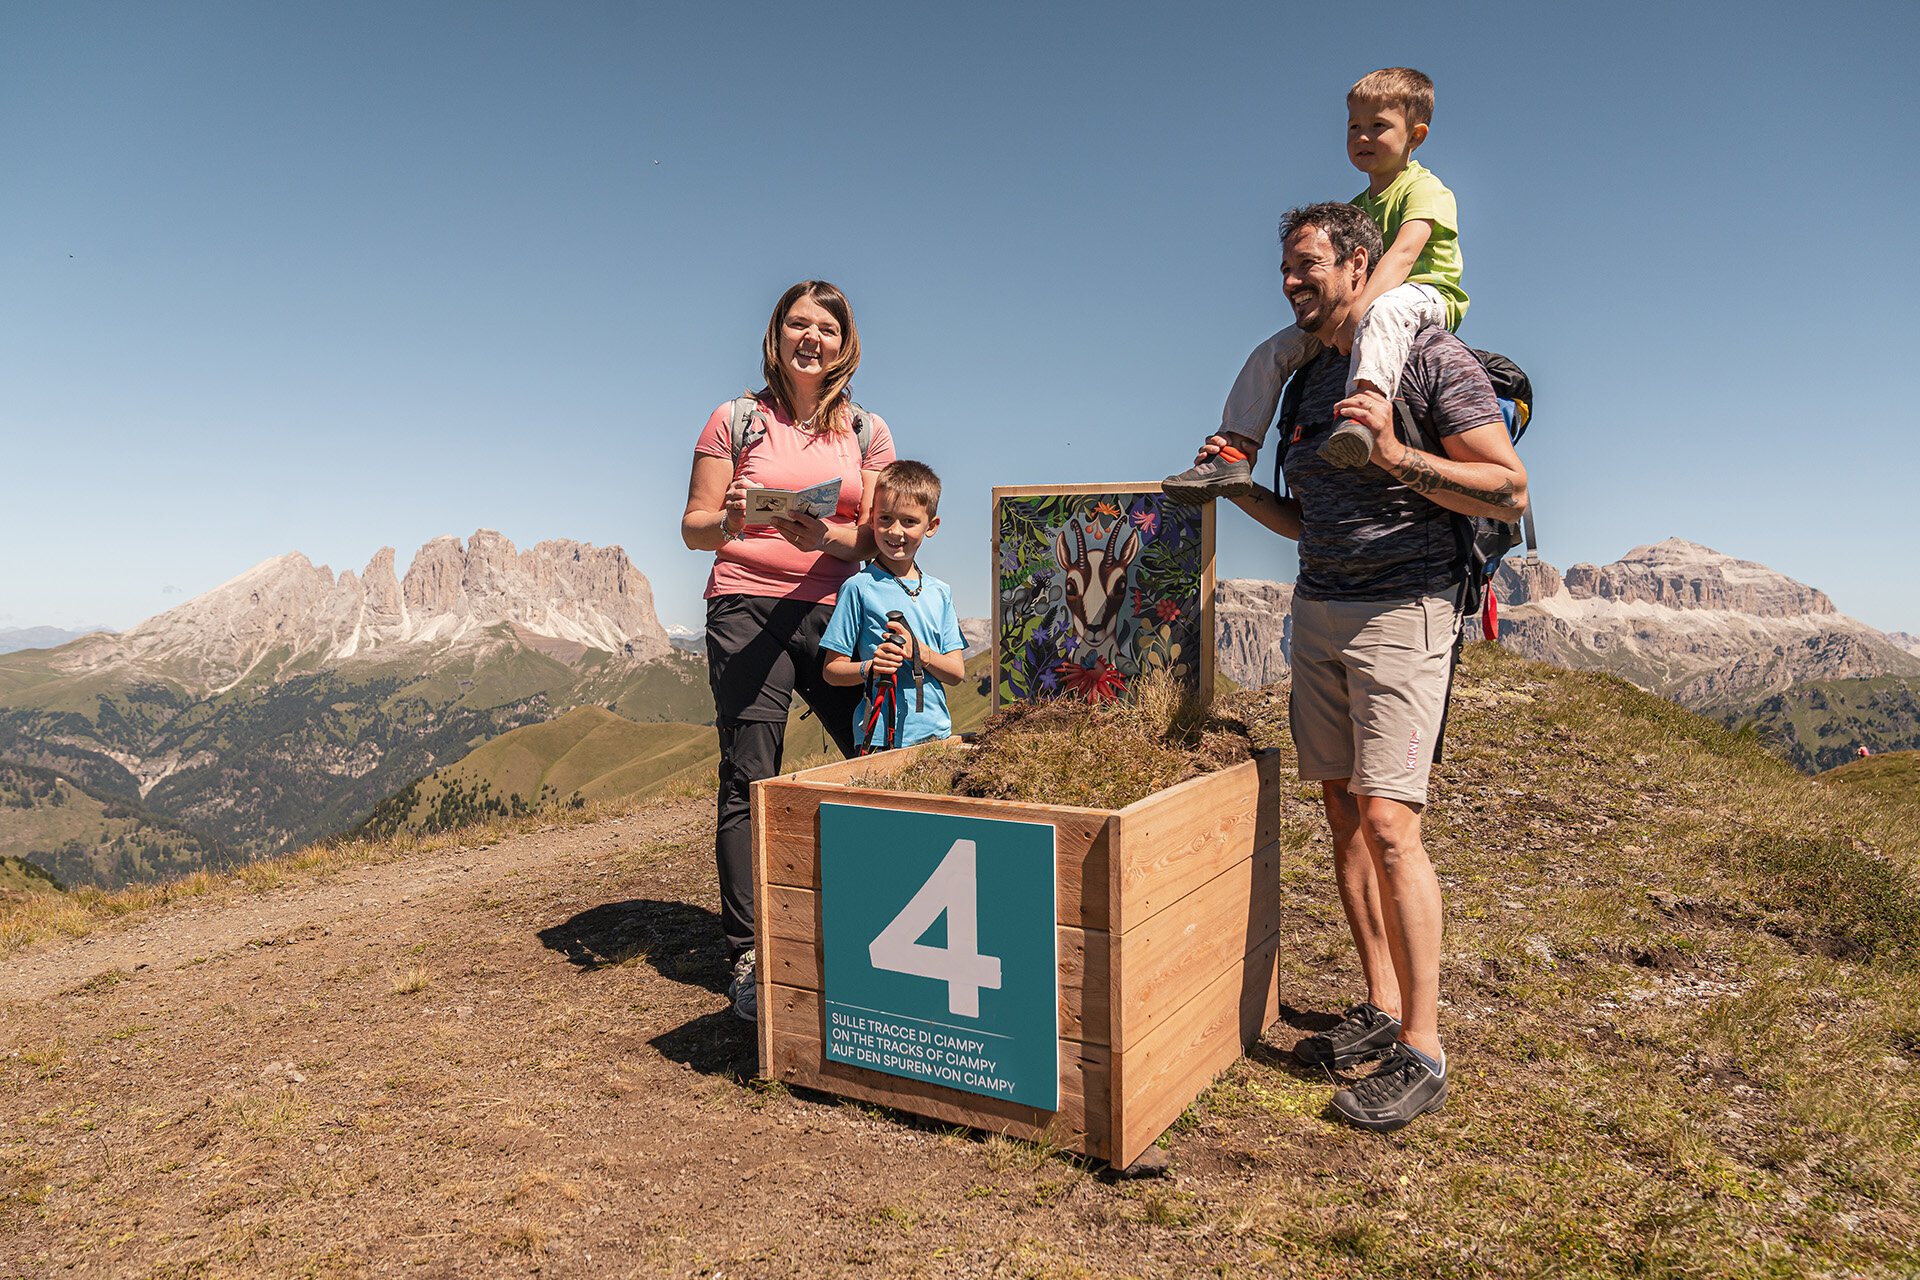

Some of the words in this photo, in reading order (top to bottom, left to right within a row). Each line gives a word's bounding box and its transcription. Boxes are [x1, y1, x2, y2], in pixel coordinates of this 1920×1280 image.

[869, 839, 1002, 1019] 4
[832, 1012, 866, 1030] SULLE
[868, 1020, 916, 1041] TRACCE
[919, 1031, 931, 1044] DI
[934, 1034, 984, 1054] CIAMPY
[832, 1028, 849, 1041] ON
[852, 1031, 874, 1048] THE
[876, 1037, 923, 1058] TRACKS
[926, 1048, 943, 1062] OF
[946, 1053, 996, 1074] CIAMPY
[832, 1043, 855, 1058] AUF
[857, 1048, 881, 1064] DEN
[883, 1054, 931, 1075] SPUREN
[933, 1064, 961, 1082] VON
[964, 1072, 1015, 1094] CIAMPY
